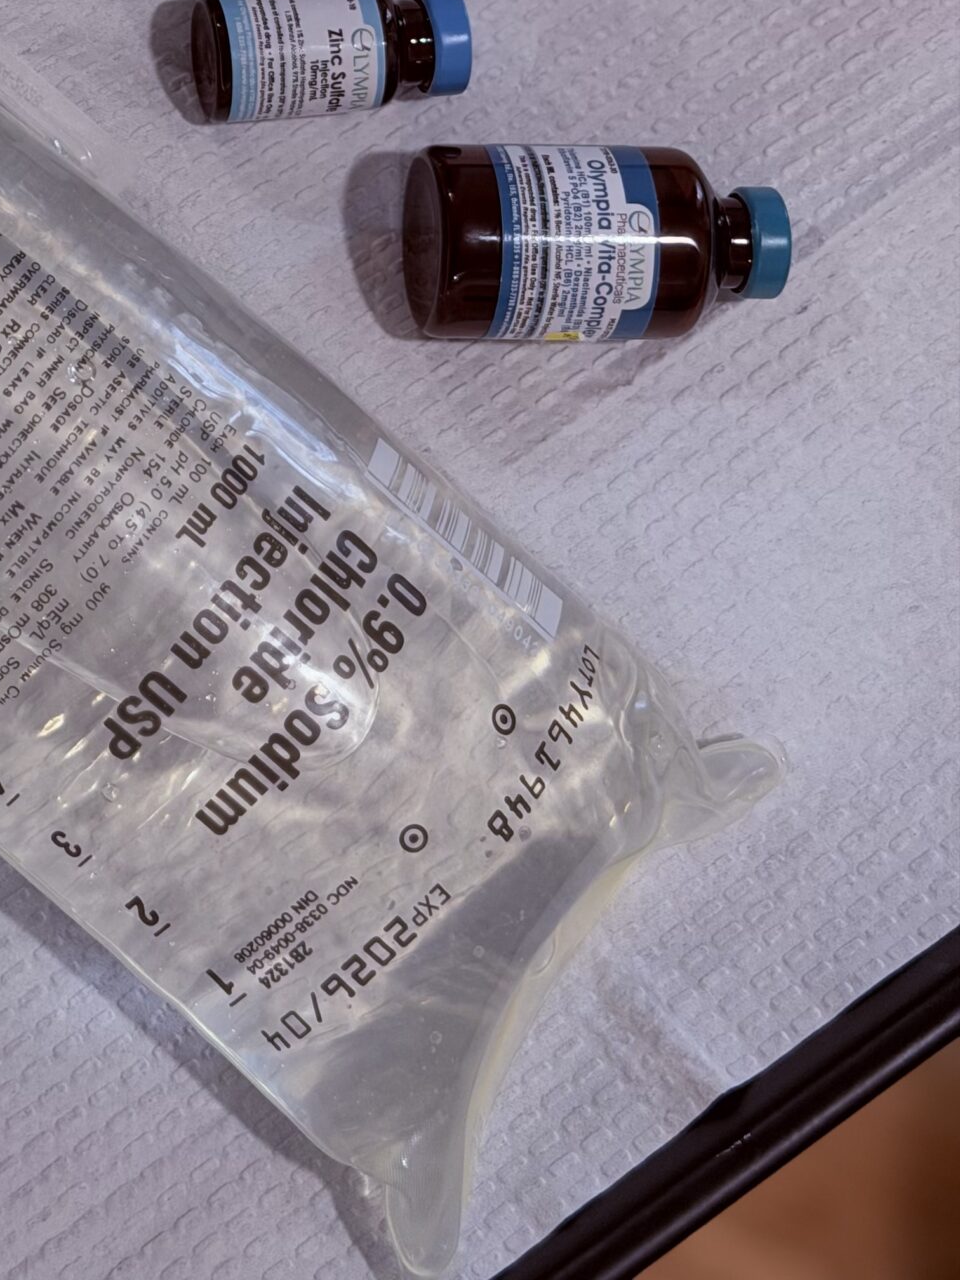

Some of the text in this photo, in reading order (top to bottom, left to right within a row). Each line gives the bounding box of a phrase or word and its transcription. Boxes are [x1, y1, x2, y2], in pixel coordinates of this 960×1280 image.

[327, 28, 343, 65] Zinc
[318, 60, 328, 99] Injection
[586, 159, 614, 229] Olympia
[560, 191, 573, 237] Pyridoxin
[582, 211, 592, 257] 100m/ml
[564, 245, 574, 265] HCL
[612, 212, 627, 303] Phamaceuticals
[49, 382, 95, 433] DOSAGE
[127, 373, 177, 431] ADDITIVES
[153, 385, 192, 430] STERILE
[163, 398, 207, 449] CHLORIDE
[198, 411, 222, 442] USP
[209, 423, 237, 454] EACH
[141, 453, 166, 479] 154
[169, 450, 189, 475] pH
[188, 457, 212, 483] 100
[64, 446, 146, 540] NONPYROGENIC
[150, 475, 173, 501] 5.0
[167, 483, 191, 507] mL
[174, 443, 266, 550] 1000 mL
[4, 512, 42, 550] WHEN
[71, 491, 135, 564] OSMOLARITY
[10, 558, 54, 604] SINGLE
[79, 554, 110, 584] 7.0)
[30, 584, 57, 612] 308
[85, 582, 111, 611] 900
[28, 597, 70, 641] mEq/L
[59, 612, 84, 635] mg
[99, 484, 332, 762] Injection USP
[230, 528, 380, 708] Chloride
[194, 572, 430, 841] 0.9% Sodium
[50, 830, 82, 859] 3
[125, 896, 159, 927] 2
[290, 889, 319, 915] DIN
[246, 875, 358, 976] NDC 0338-0049-04
[205, 968, 235, 995] 1
[258, 940, 313, 990] 2B1324
